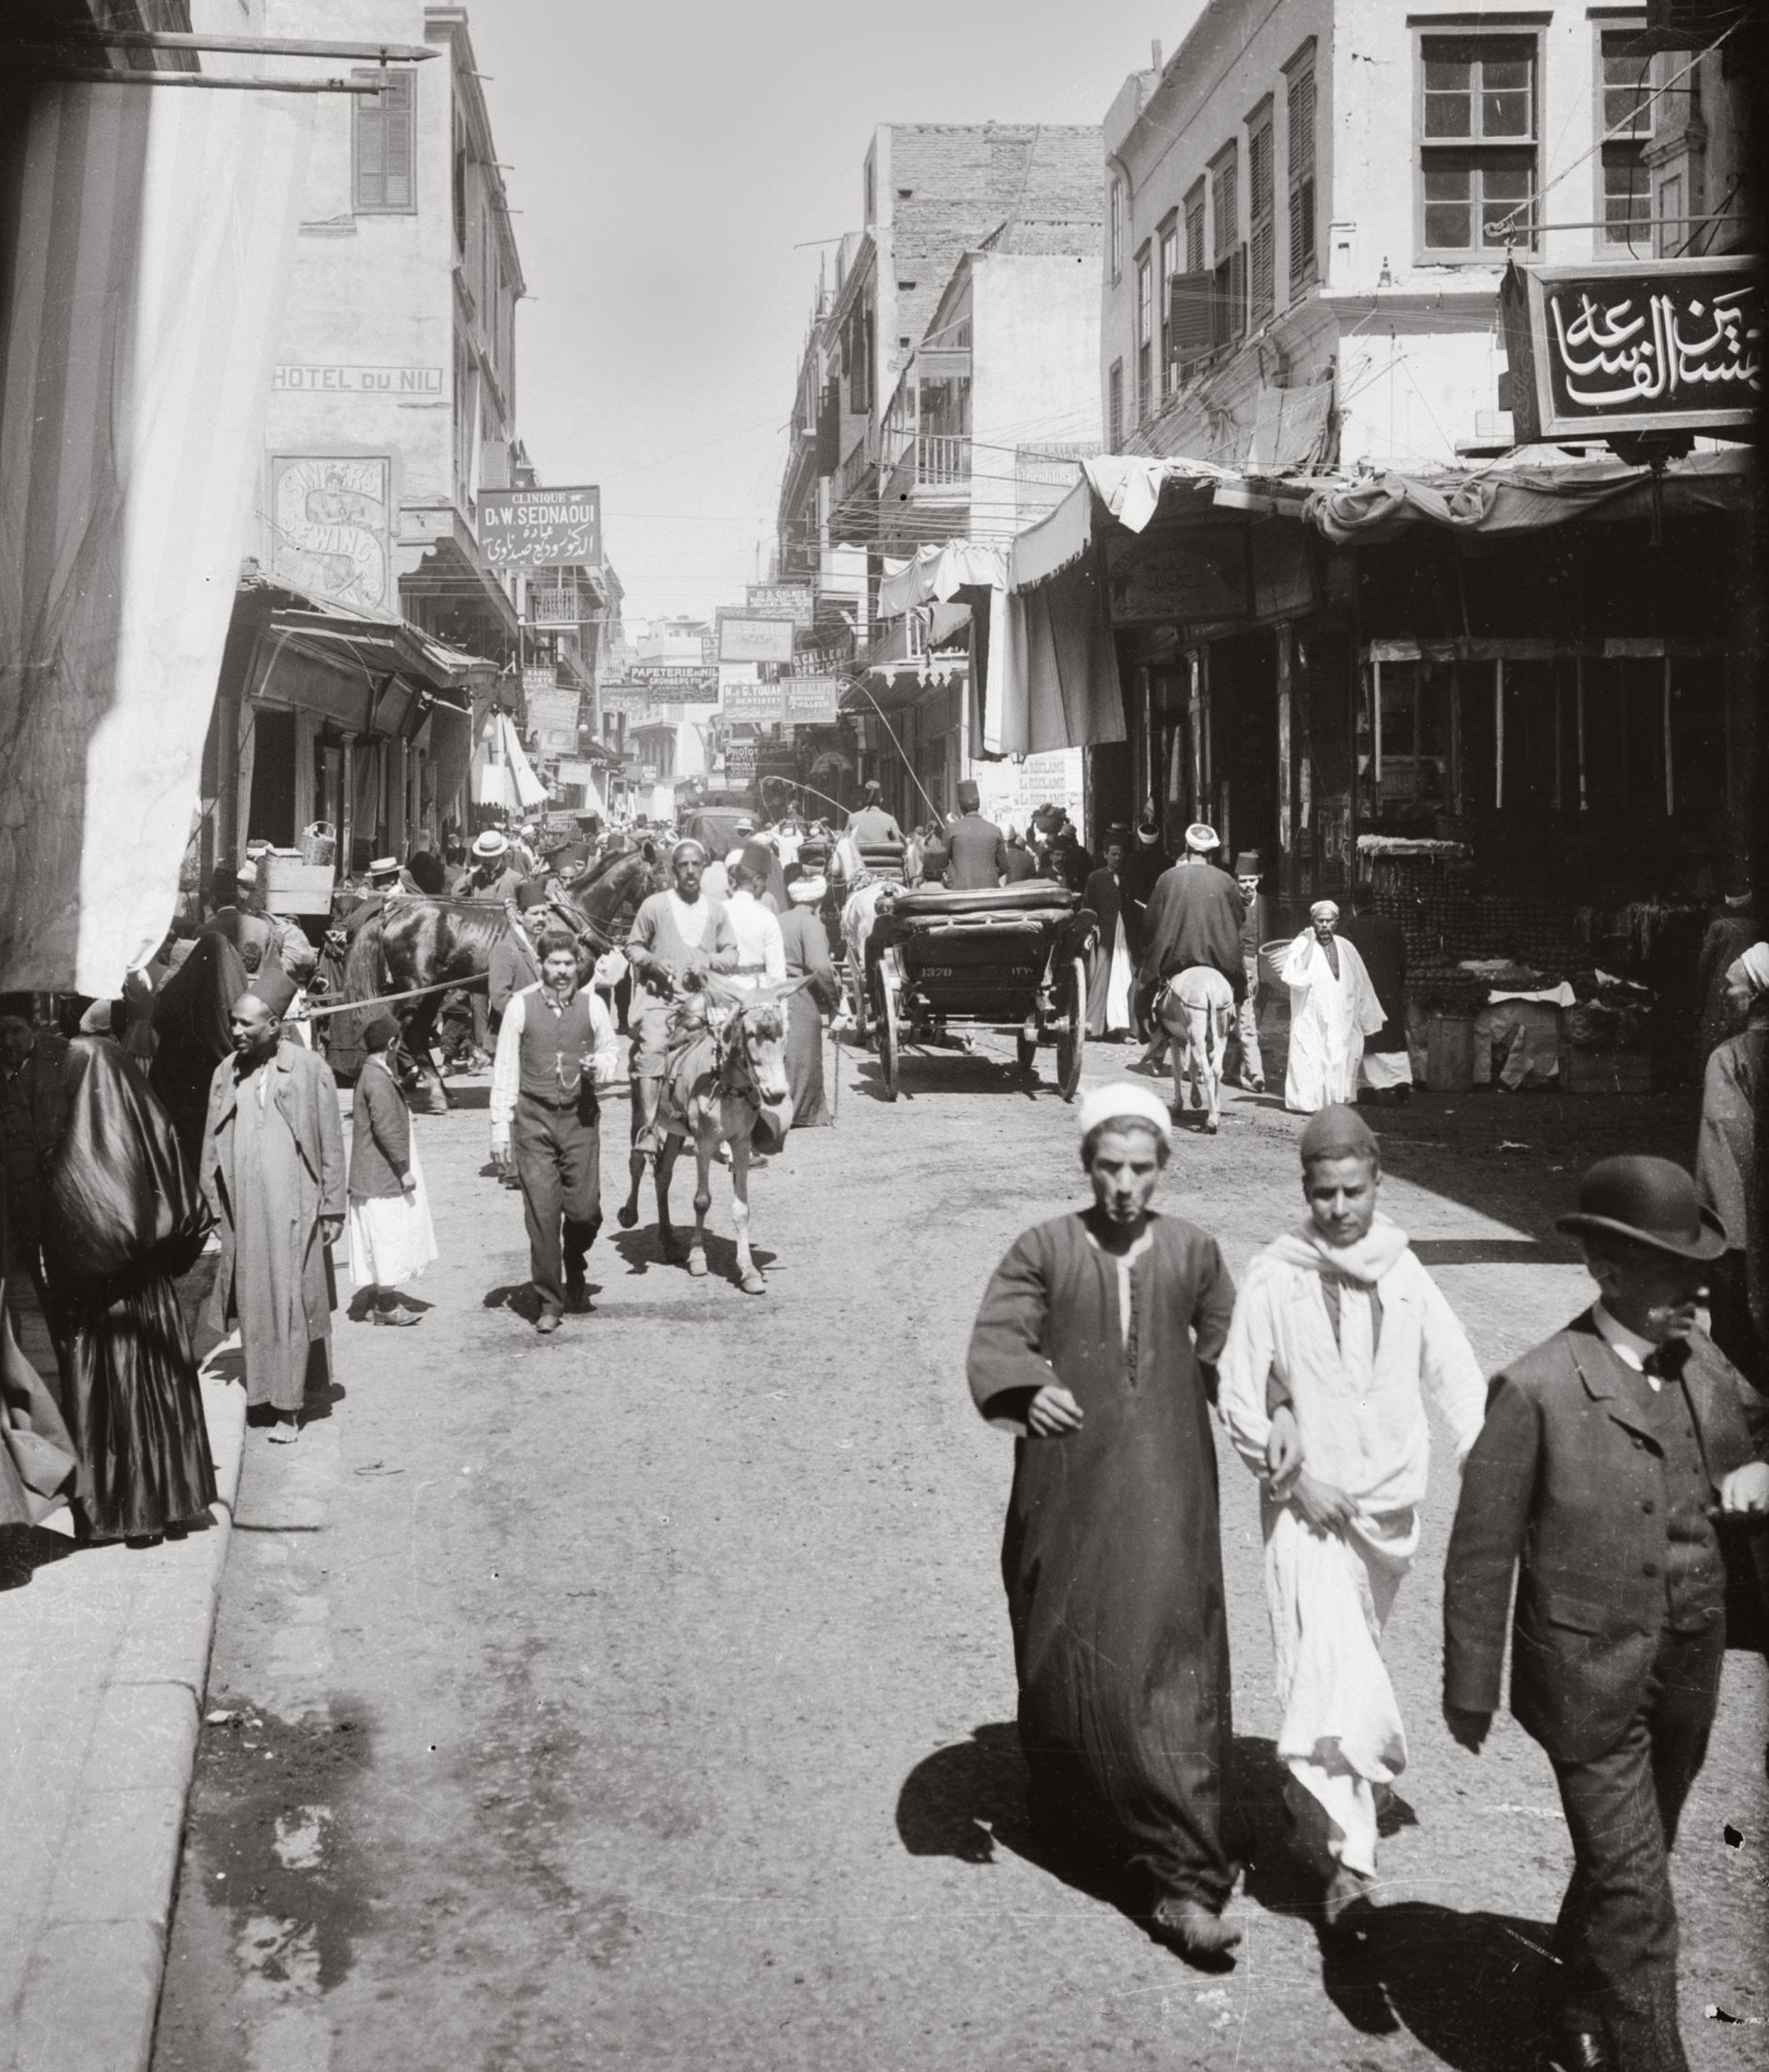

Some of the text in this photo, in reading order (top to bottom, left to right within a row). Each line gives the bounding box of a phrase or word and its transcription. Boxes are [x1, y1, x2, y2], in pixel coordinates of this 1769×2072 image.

[272, 368, 439, 391] HOTEL DU NIL
[512, 493, 566, 504] CLINIQUE
[518, 504, 594, 525] SEDNAOUI
[632, 668, 693, 677] PAPETERIE
[701, 668, 719, 677] NIL
